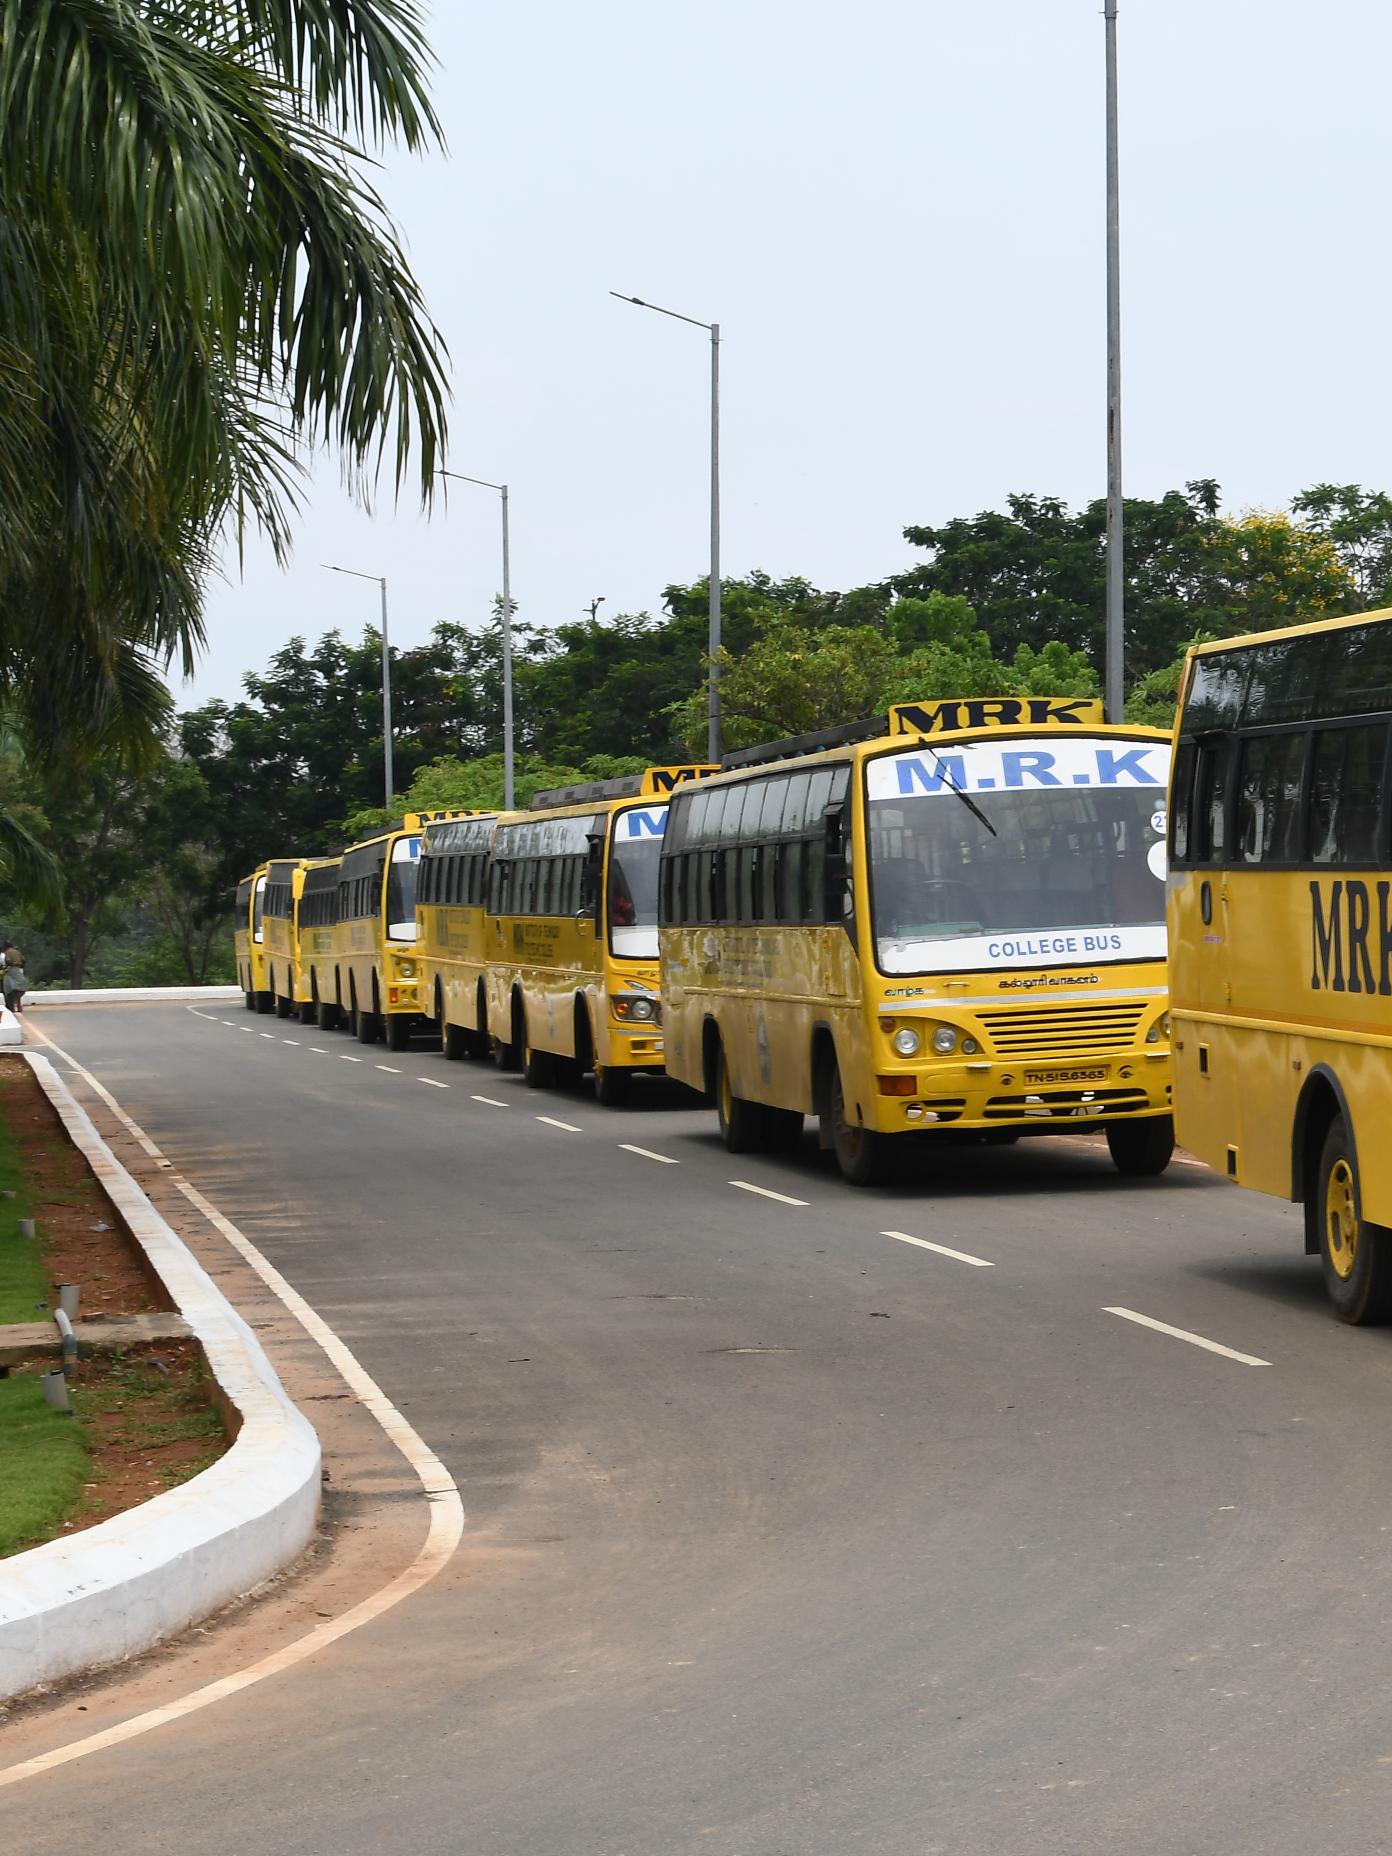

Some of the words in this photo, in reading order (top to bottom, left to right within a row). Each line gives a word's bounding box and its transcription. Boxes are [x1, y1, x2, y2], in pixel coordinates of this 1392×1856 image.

[894, 700, 1093, 735] MRK
[895, 749, 1160, 795] M.R.K
[988, 937, 1078, 958] COLLEGE
[1084, 934, 1122, 951] BUS
